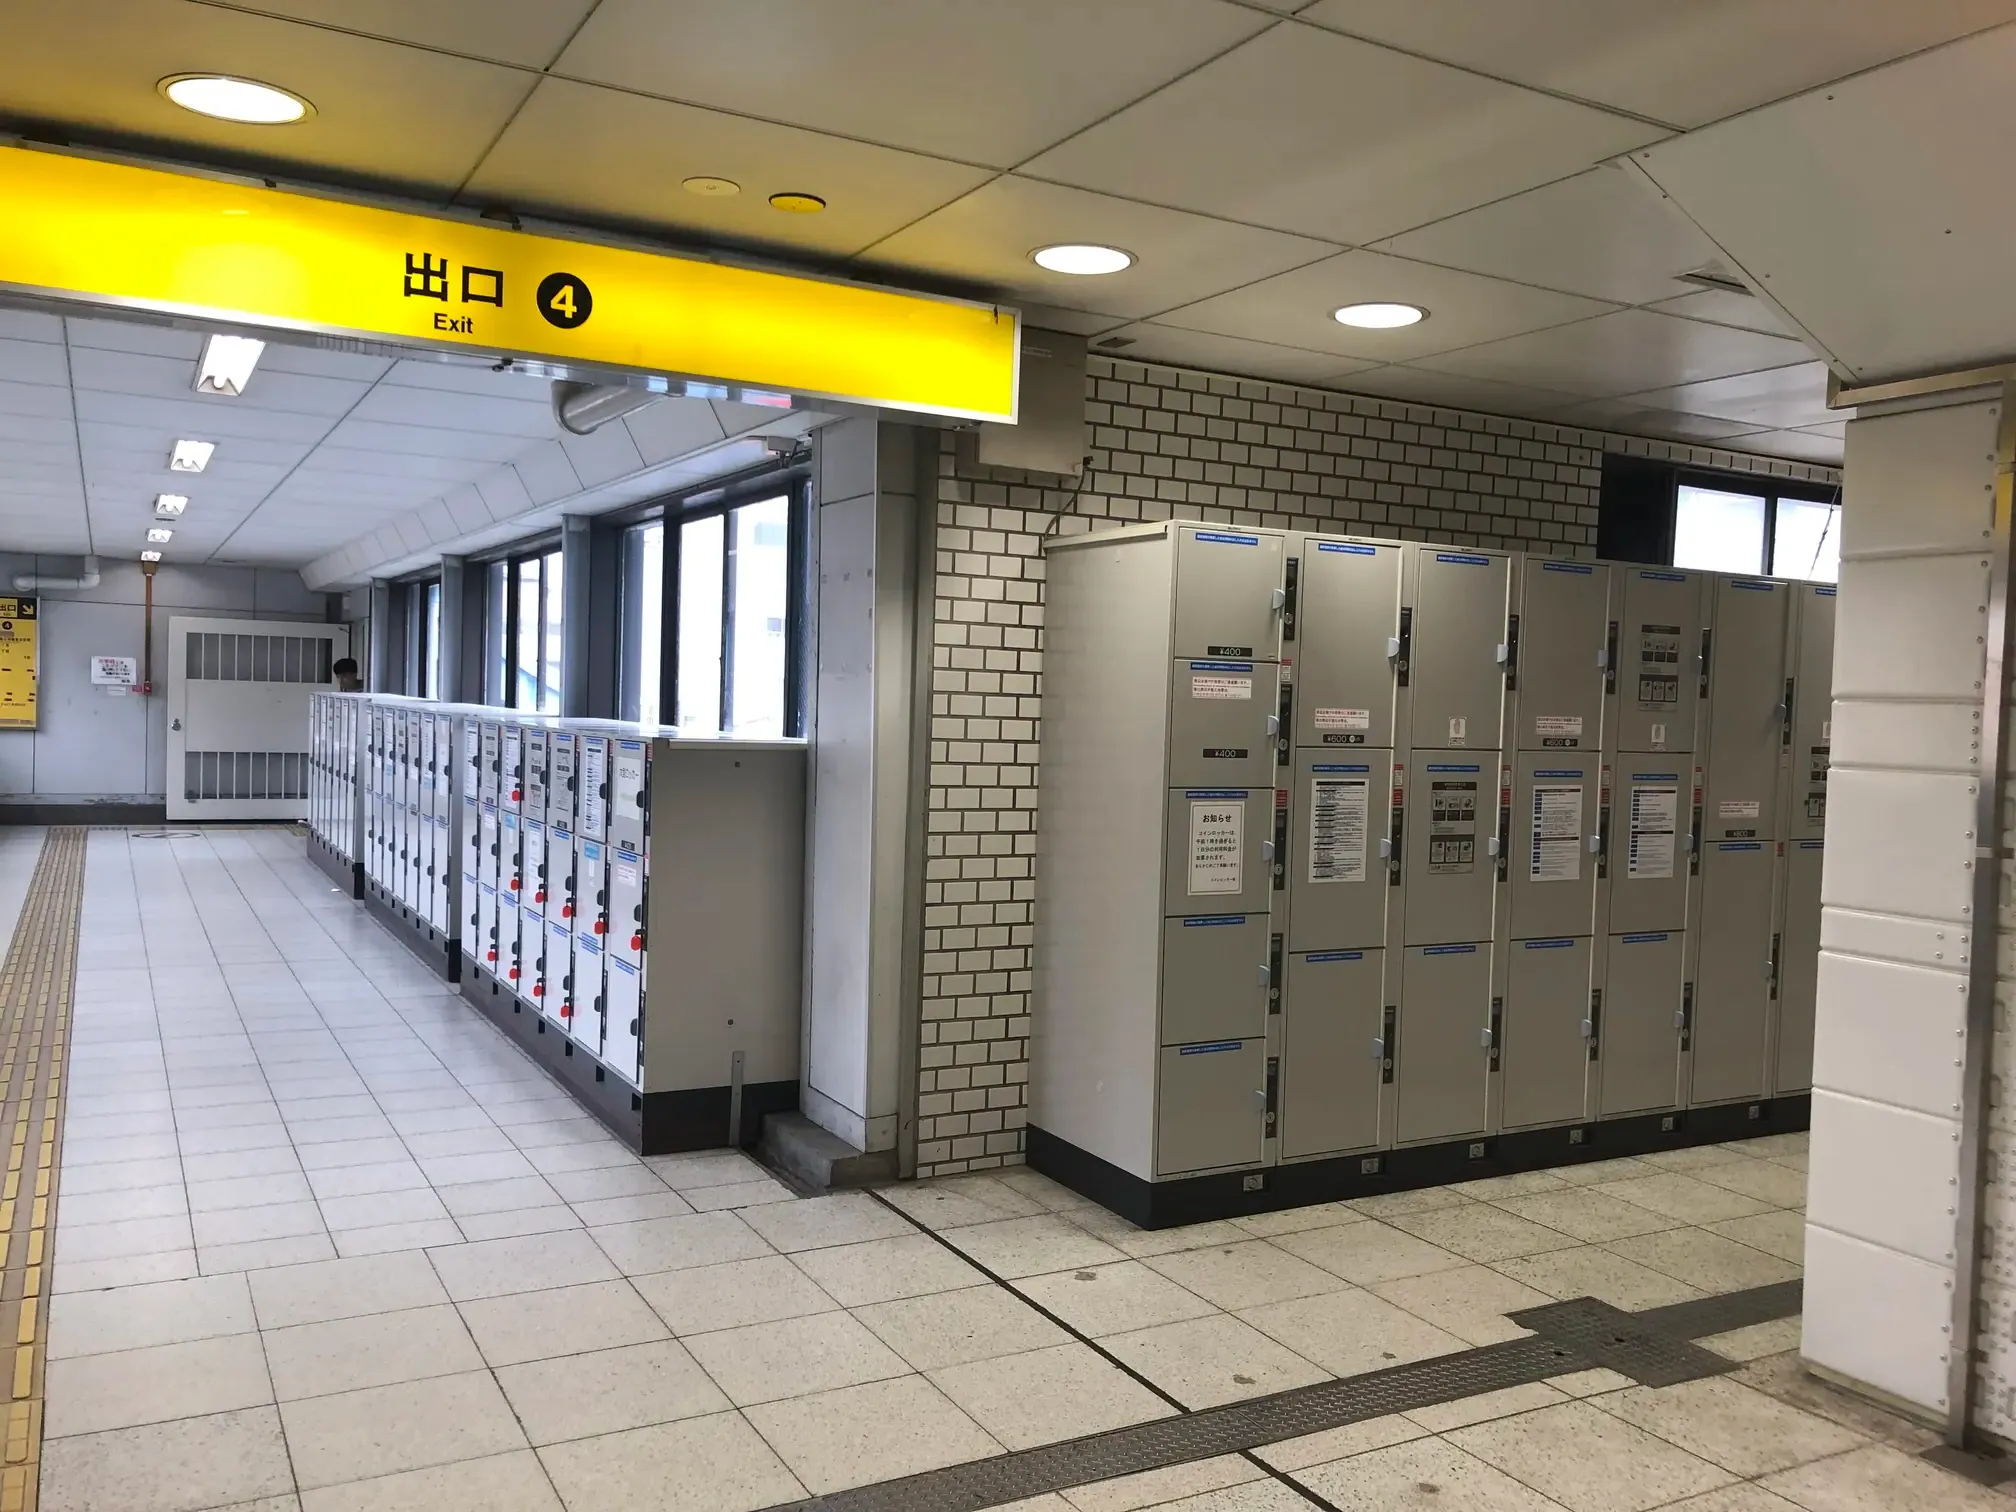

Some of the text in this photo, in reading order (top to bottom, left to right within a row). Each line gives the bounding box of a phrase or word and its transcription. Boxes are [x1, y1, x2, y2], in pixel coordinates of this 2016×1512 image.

[404, 252, 577, 319] 出口 4
[433, 312, 474, 334] Exit
[1219, 647, 1241, 656] ¥400
[1214, 749, 1236, 758] ¥400
[1202, 814, 1232, 823] お知らせ
